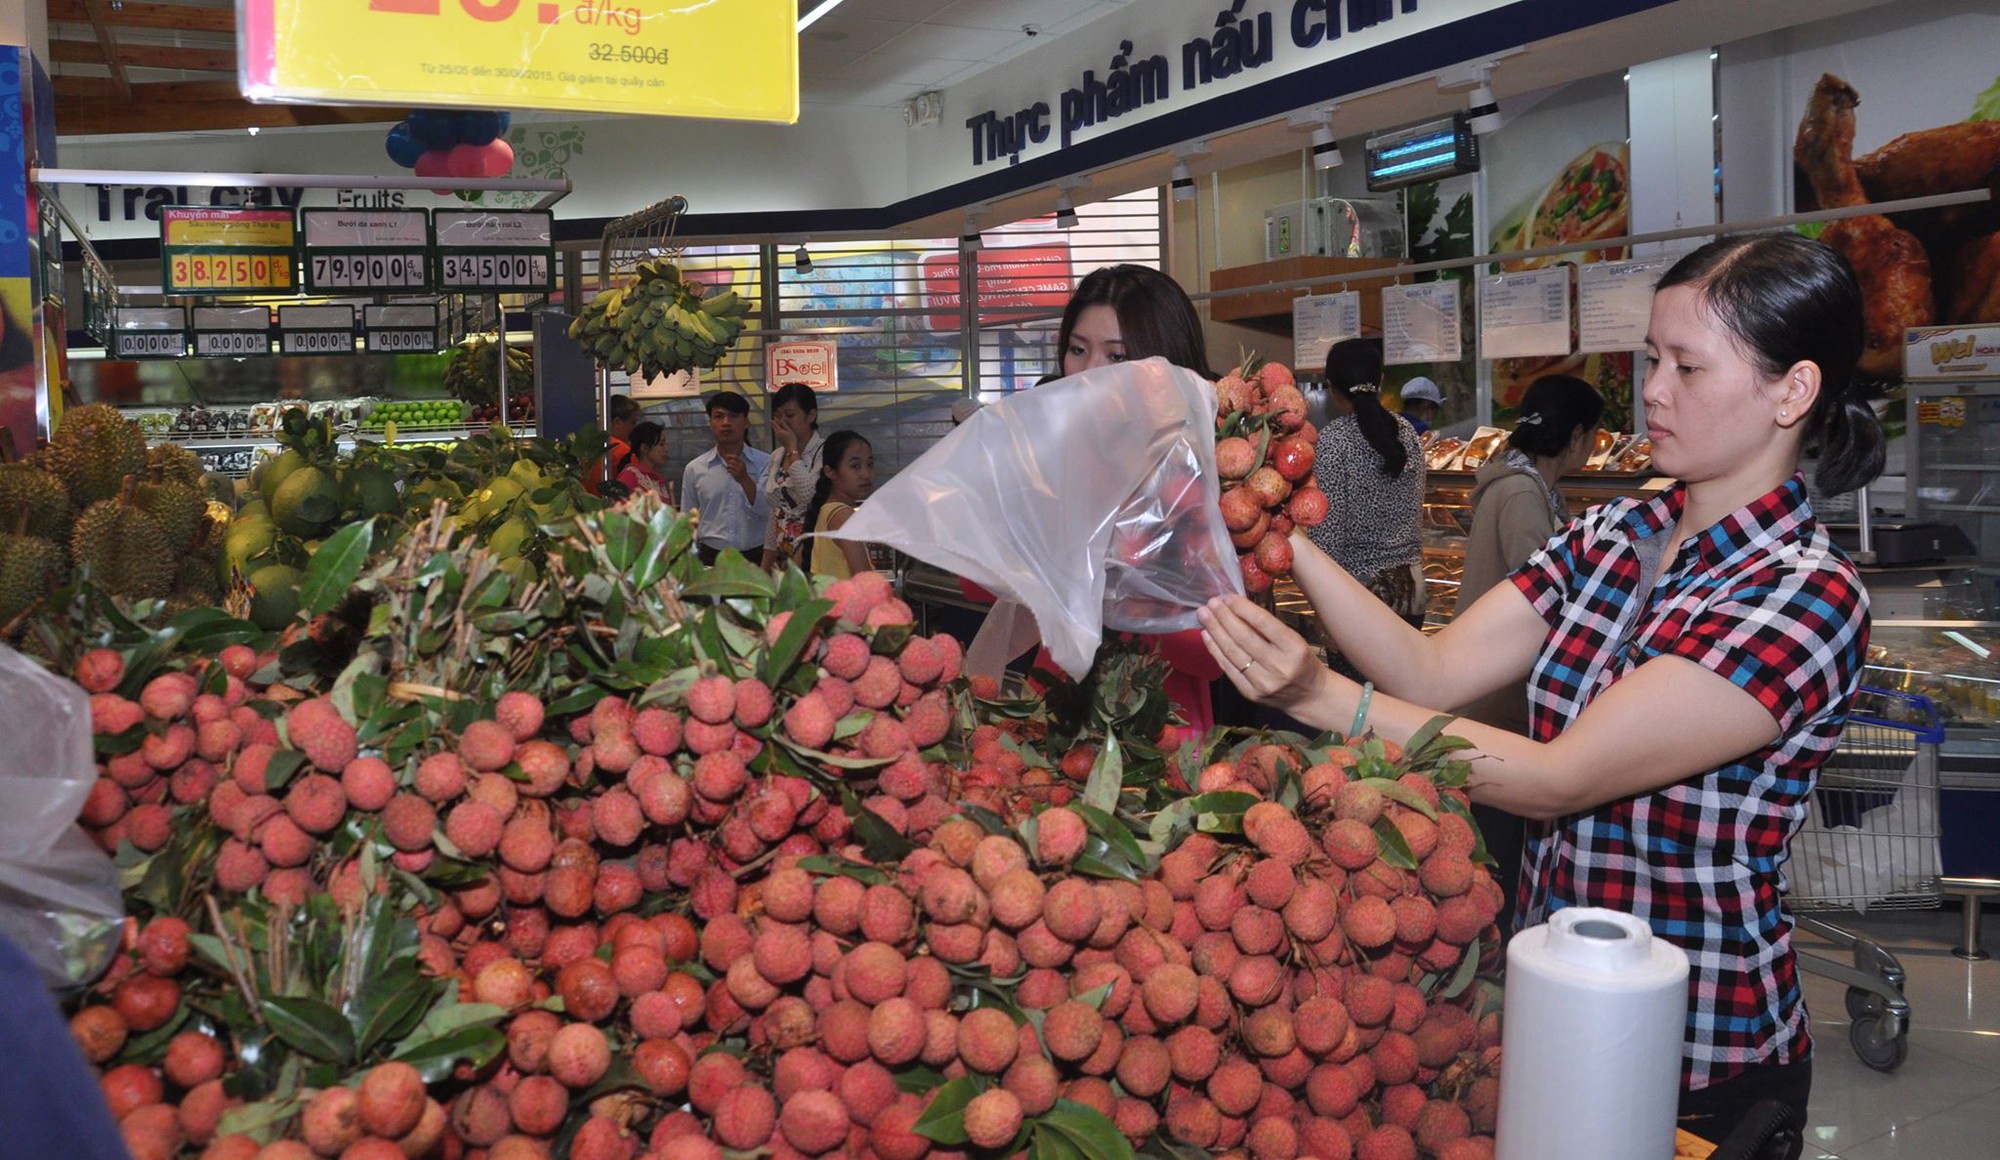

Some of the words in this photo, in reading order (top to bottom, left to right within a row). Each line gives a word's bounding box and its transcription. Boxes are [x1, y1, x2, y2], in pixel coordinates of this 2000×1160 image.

[589, 42, 669, 65] 32.500đ
[966, 101, 1051, 166] Thực
[1060, 39, 1169, 149] phẩm
[1182, 0, 1273, 90] nấu
[175, 259, 267, 283] 38.250
[315, 258, 403, 280] 79.900
[446, 258, 527, 279] 34.500
[211, 336, 254, 349] 0.000
[296, 335, 338, 348] 0.000
[380, 333, 422, 347] 0.000
